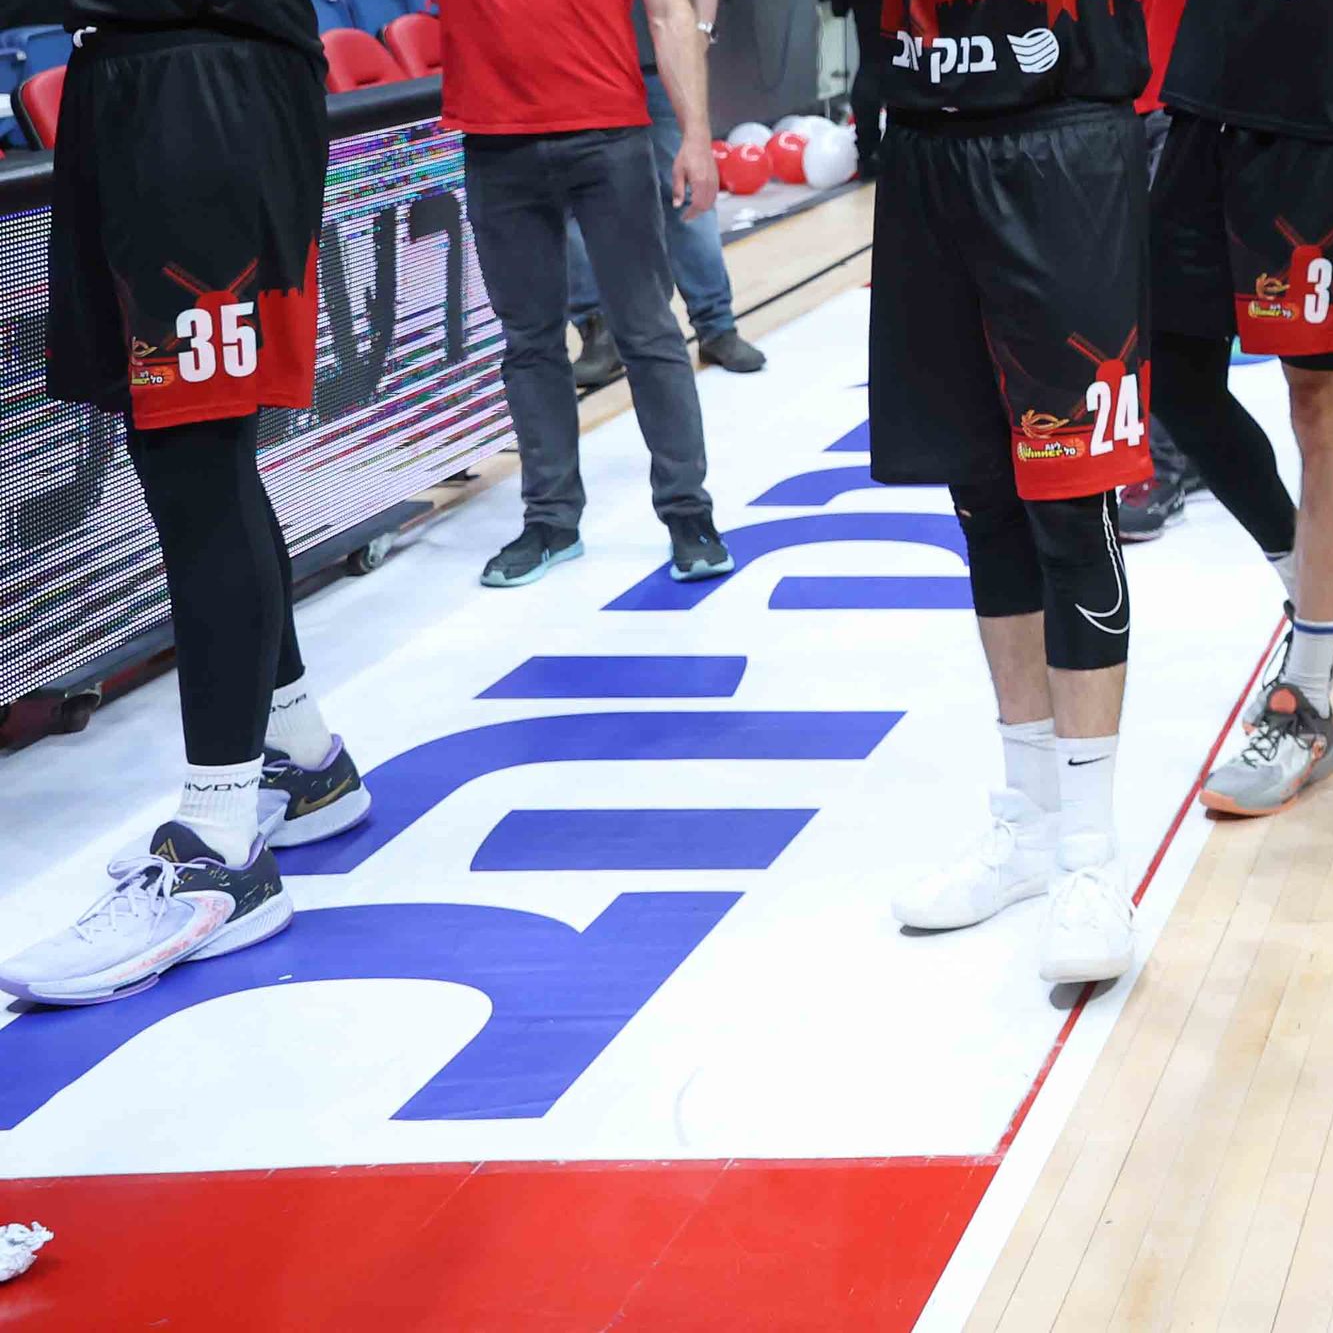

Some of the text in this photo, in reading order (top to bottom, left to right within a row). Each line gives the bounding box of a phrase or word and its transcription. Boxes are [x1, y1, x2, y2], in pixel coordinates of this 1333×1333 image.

[929, 35, 997, 83] בנק
[1303, 257, 1333, 324] 3
[176, 300, 258, 382] 35
[1085, 373, 1145, 457] 24
[1020, 446, 1063, 459] Winner
